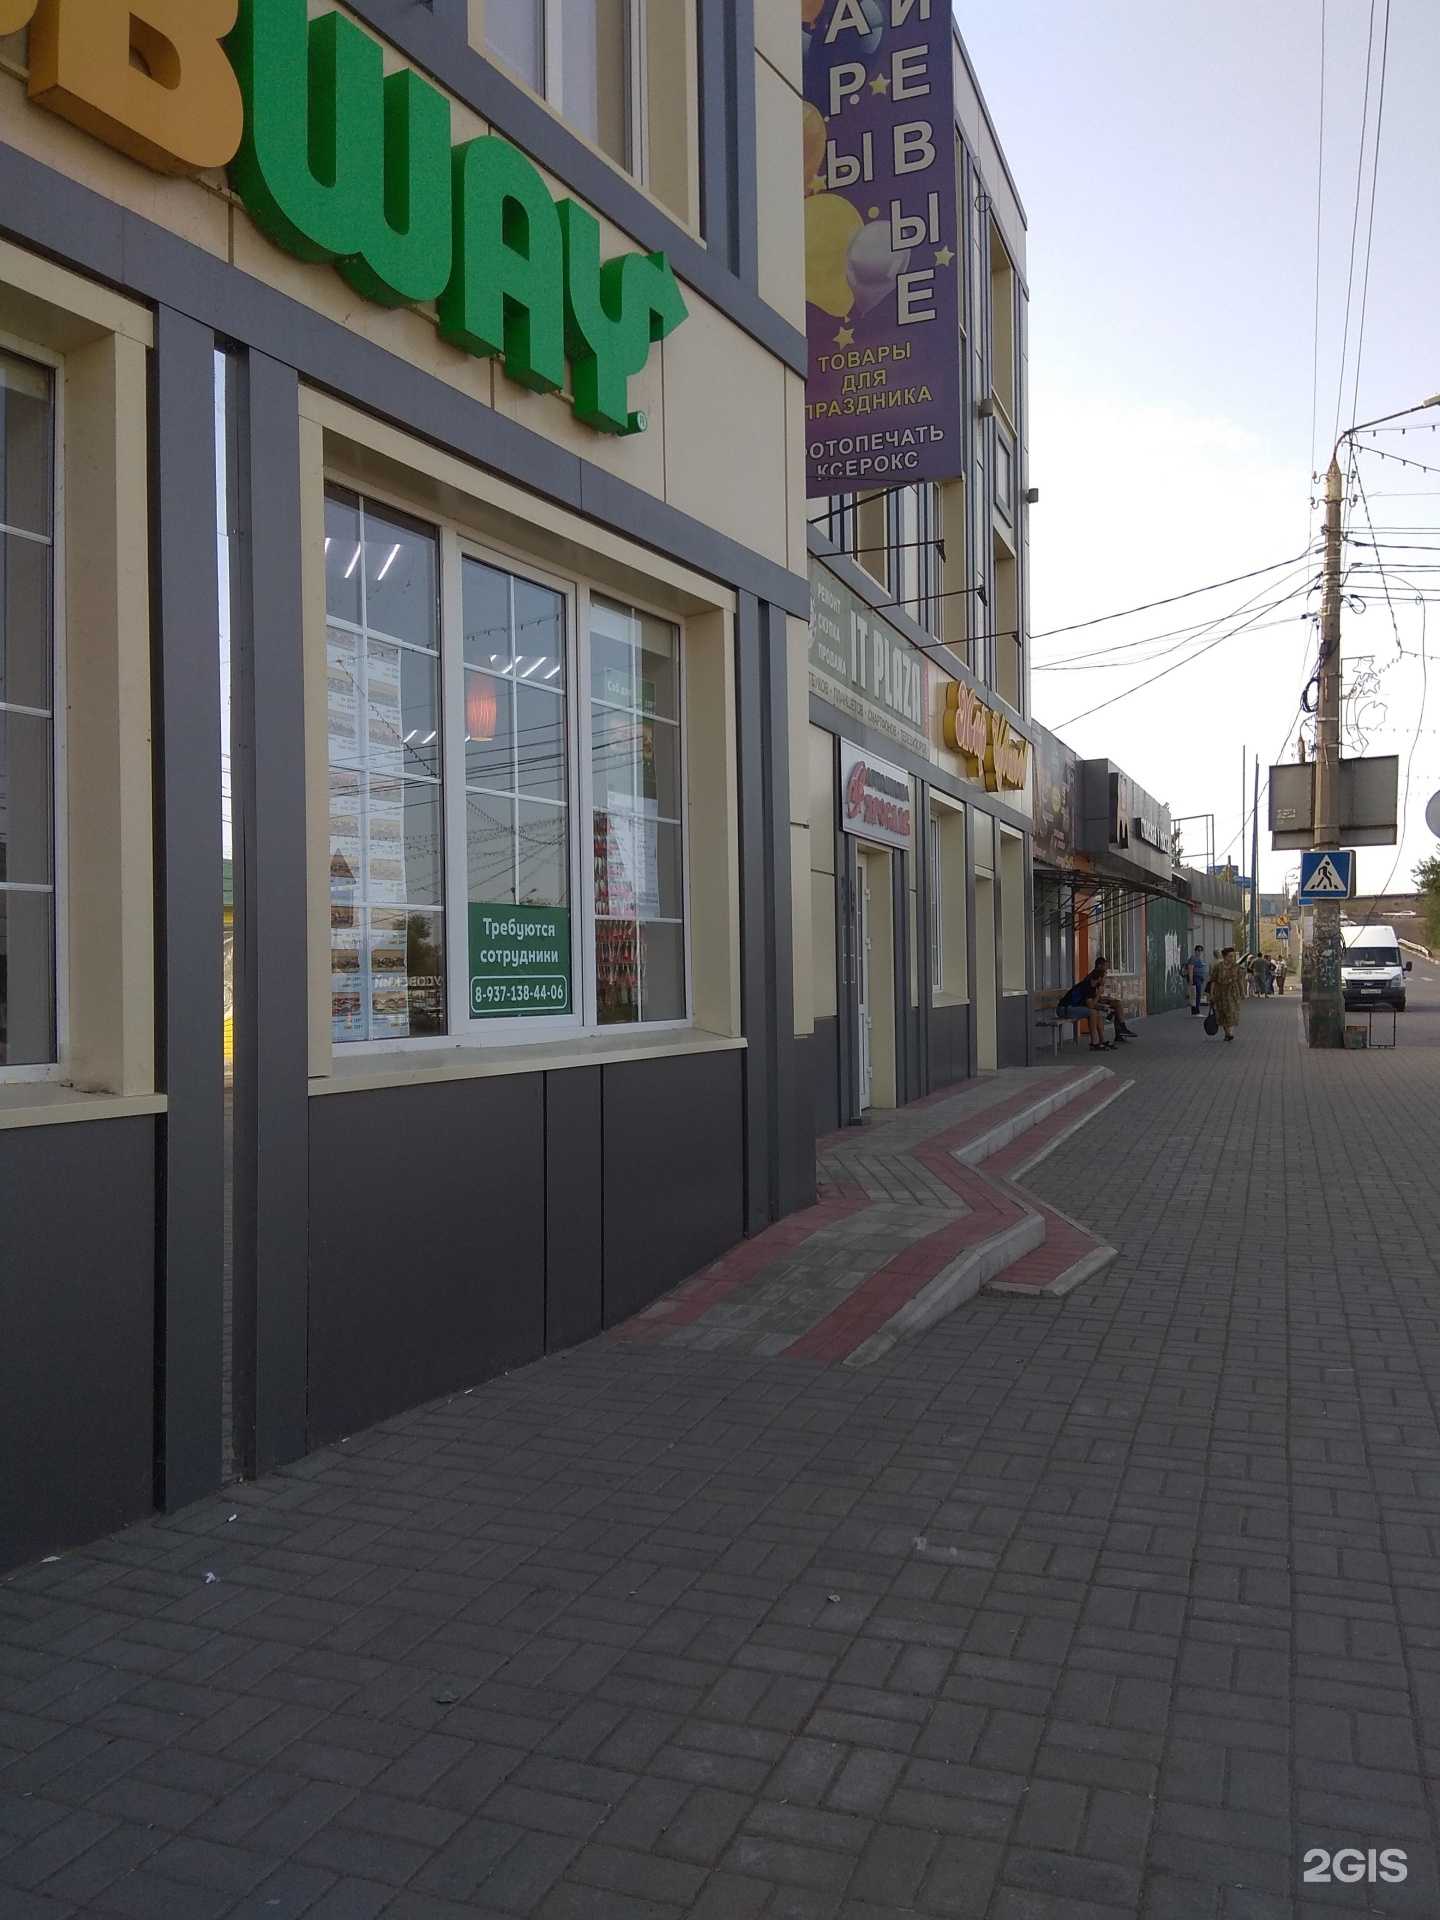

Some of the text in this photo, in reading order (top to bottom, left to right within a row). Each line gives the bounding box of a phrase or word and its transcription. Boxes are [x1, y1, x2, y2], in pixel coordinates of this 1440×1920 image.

[817, 341, 912, 373] ТОВАРЫ
[841, 369, 887, 395] ДЛЯ
[806, 424, 945, 460] ОТОПЕЧАТЬ
[817, 451, 919, 481] КСЕРОКС
[850, 609, 922, 726] IT PLAZA
[482, 917, 556, 940] Требуются
[480, 949, 559, 967] сотрудники
[475, 984, 564, 1003] 8-937-138-44-06
